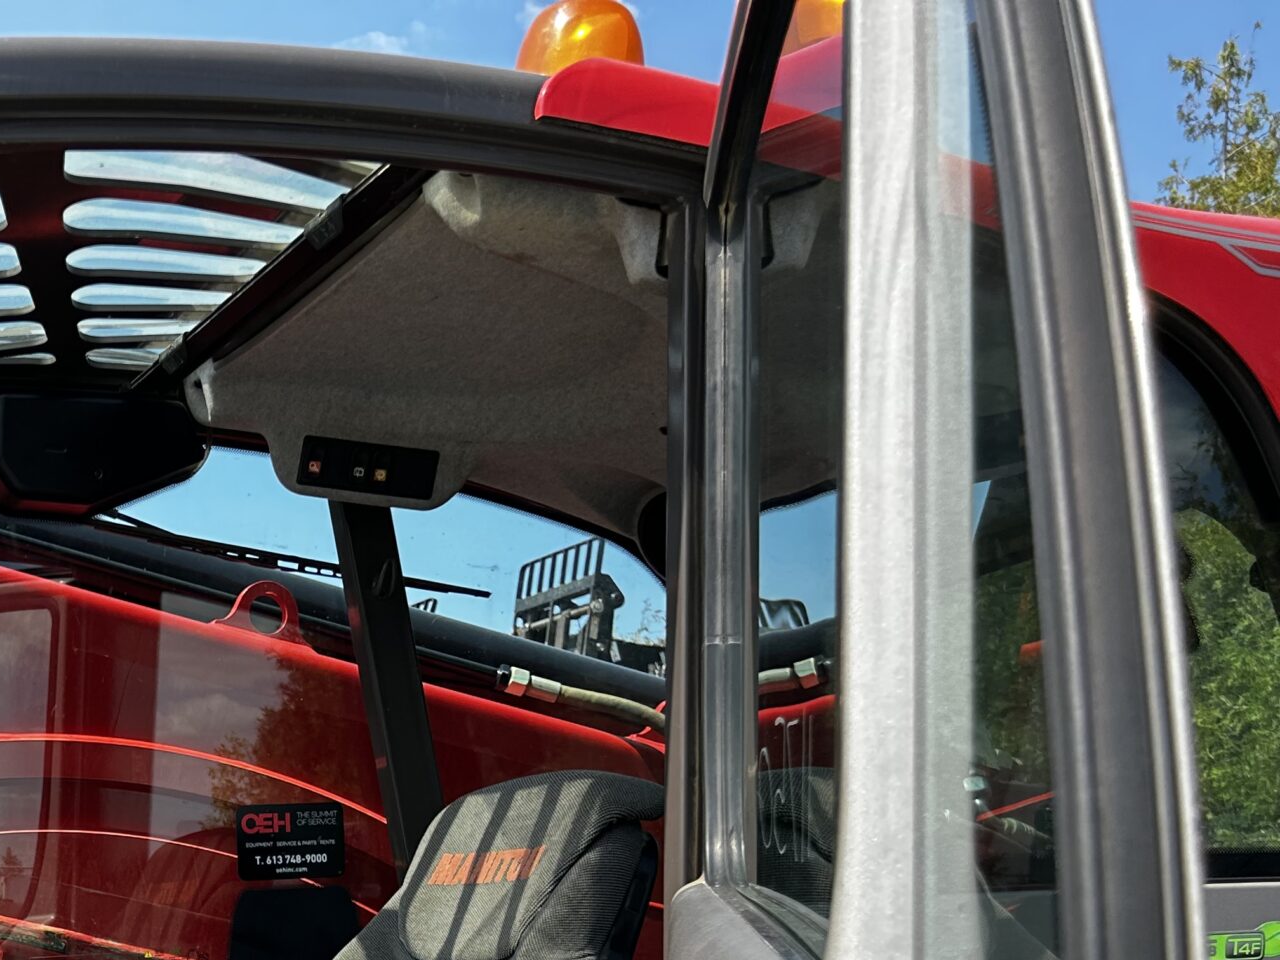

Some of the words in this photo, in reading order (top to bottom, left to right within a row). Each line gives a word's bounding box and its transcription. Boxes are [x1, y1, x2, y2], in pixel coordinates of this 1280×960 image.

[241, 812, 291, 834] OEH
[296, 811, 310, 819] THE
[311, 810, 338, 819] SUMMIT
[308, 818, 337, 826] SERVICE
[255, 856, 264, 866] T.
[266, 855, 283, 865] 613
[285, 853, 328, 864] 748-9000
[1228, 937, 1262, 956] T4F
